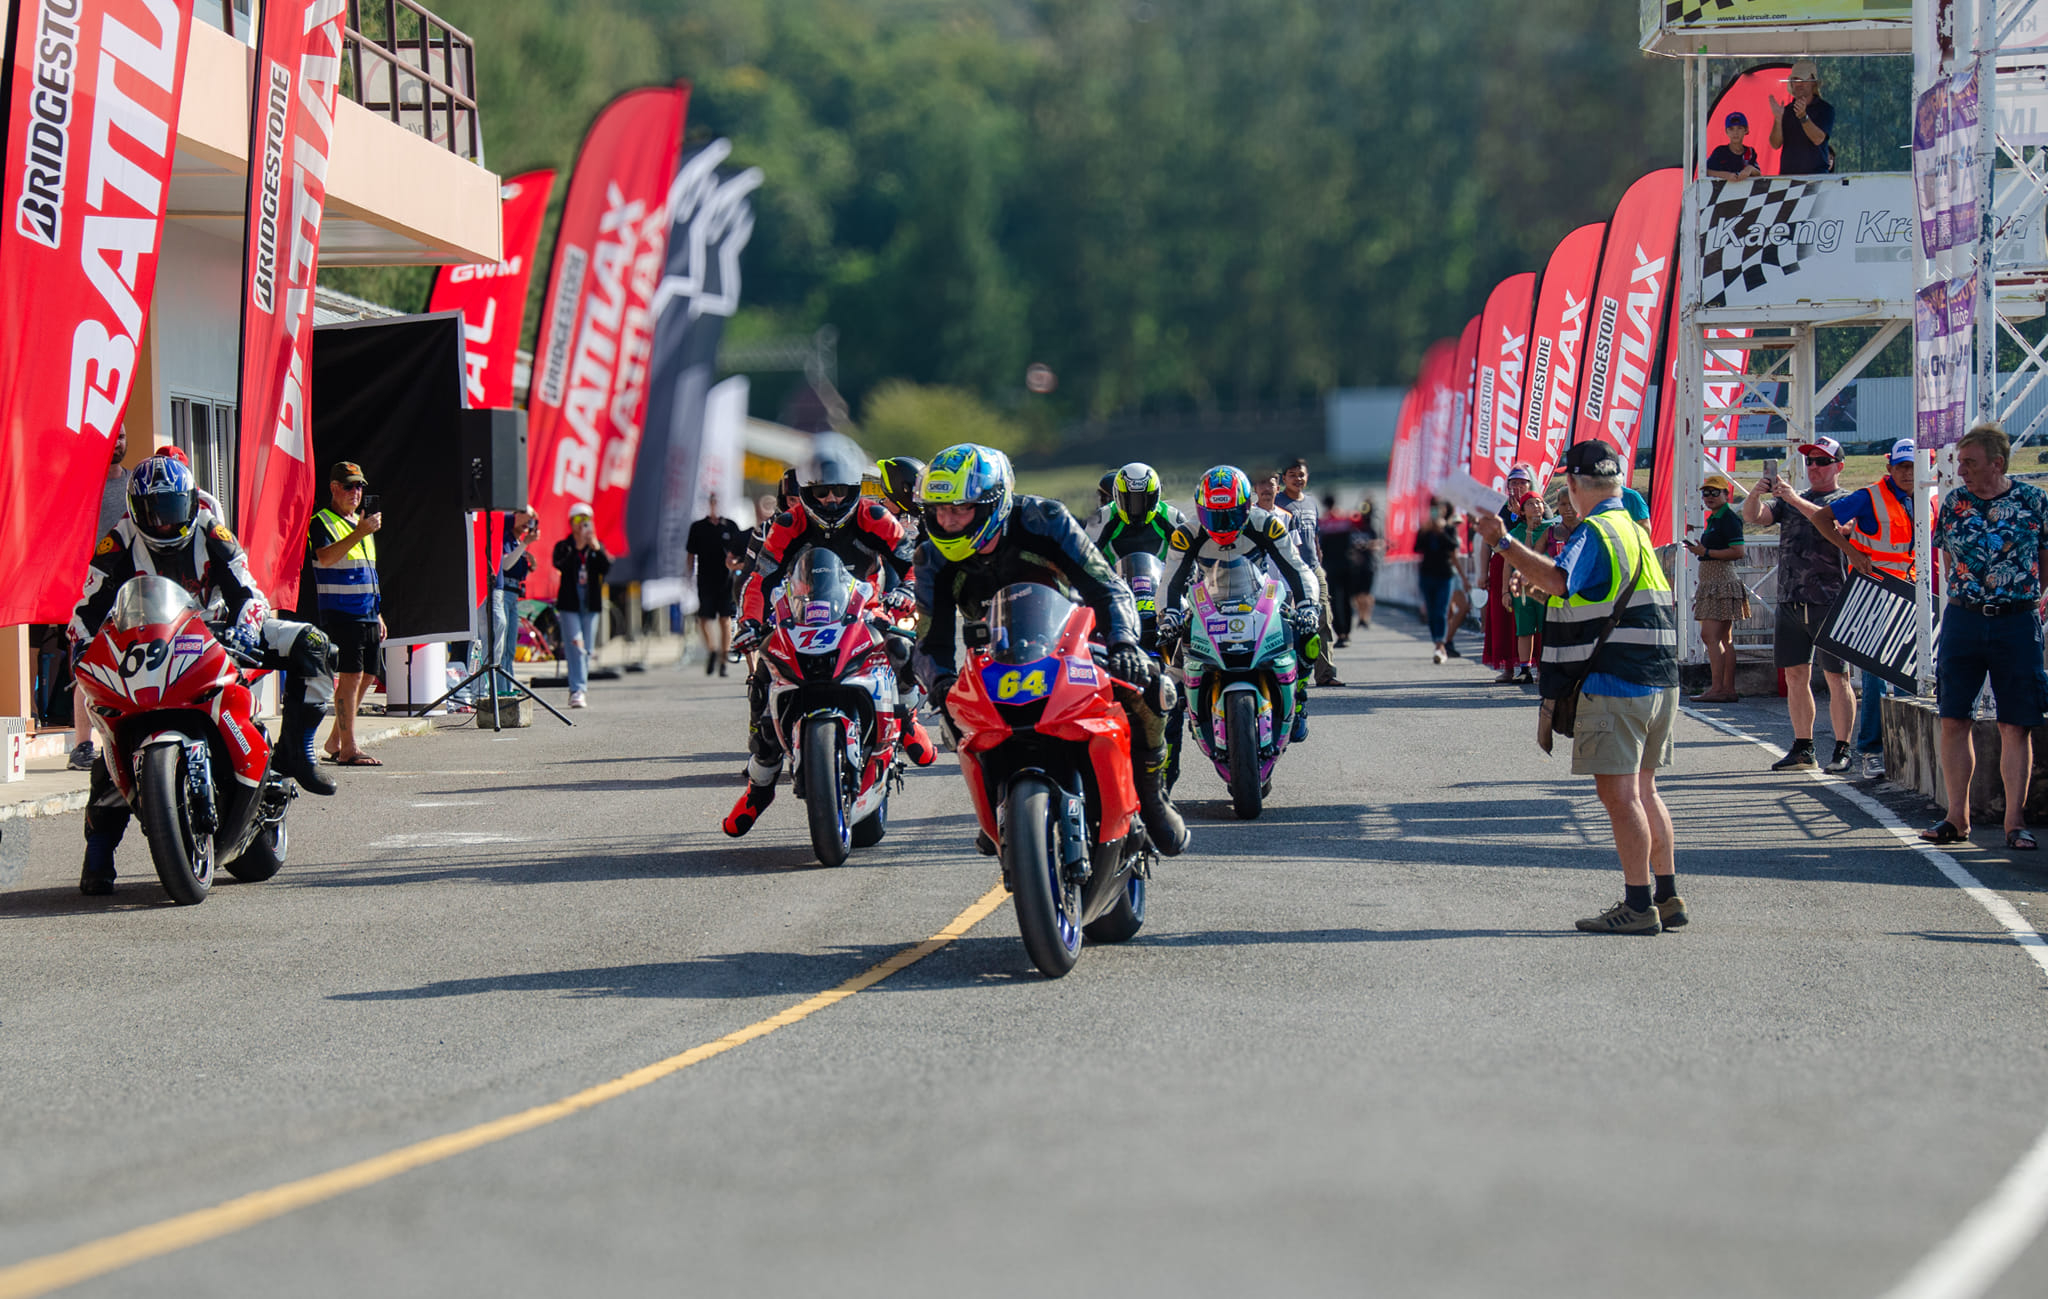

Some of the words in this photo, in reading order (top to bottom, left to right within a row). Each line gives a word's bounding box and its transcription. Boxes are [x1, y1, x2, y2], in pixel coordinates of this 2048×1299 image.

[18, 0, 79, 245] BRIDGESTO
[66, 0, 181, 440] BATTL
[255, 64, 291, 313] BRIDGESTONE
[450, 255, 522, 283] GWM
[1711, 213, 1844, 253] Kaeng
[541, 246, 586, 405] BRIDGESTONE
[553, 181, 645, 501] BATTLAX
[1585, 296, 1618, 421] BRIDGESTONE
[1476, 366, 1494, 458] BRIDGESTONE
[1526, 336, 1552, 440] BRIDGESTONE
[929, 483, 950, 491] SHOEI
[118, 638, 169, 678] 69
[799, 629, 838, 648] 74
[1829, 576, 1904, 659] WARM
[999, 669, 1048, 699] 64
[1069, 666, 1093, 679] 301
[14, 736, 20, 773] 2
